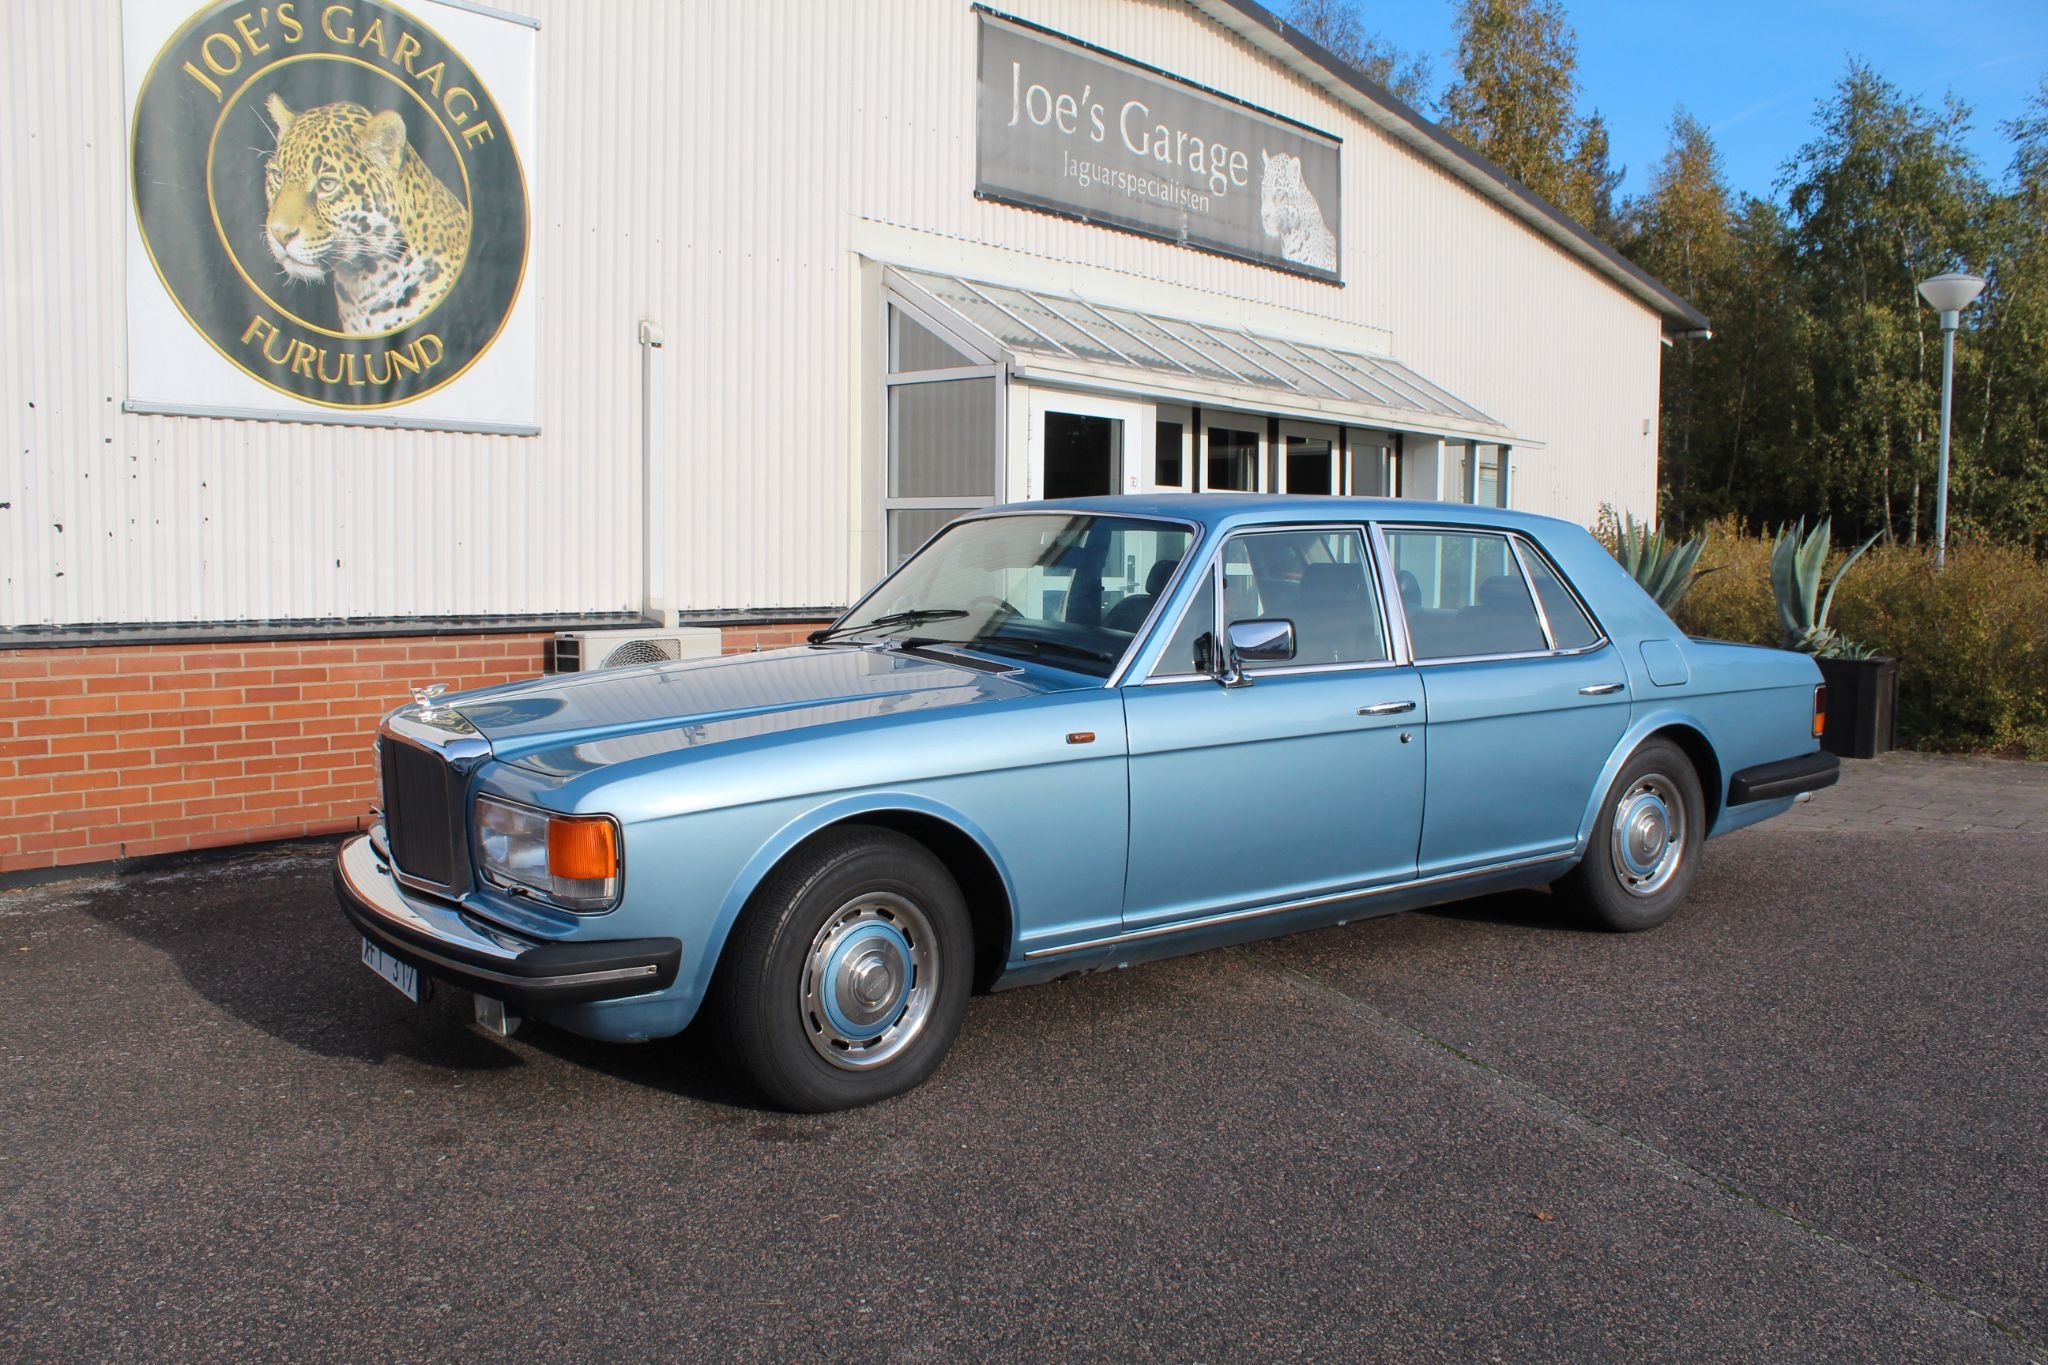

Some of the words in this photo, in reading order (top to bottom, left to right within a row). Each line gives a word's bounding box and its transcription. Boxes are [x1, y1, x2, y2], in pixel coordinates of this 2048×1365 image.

[183, 4, 304, 102] JOE'S
[320, 5, 495, 151] GARAGE
[1008, 61, 1105, 142] Joe's
[1120, 101, 1248, 197] Garage
[1063, 150, 1210, 213] Jaguarspecialisten
[241, 314, 444, 386] FURULUND
